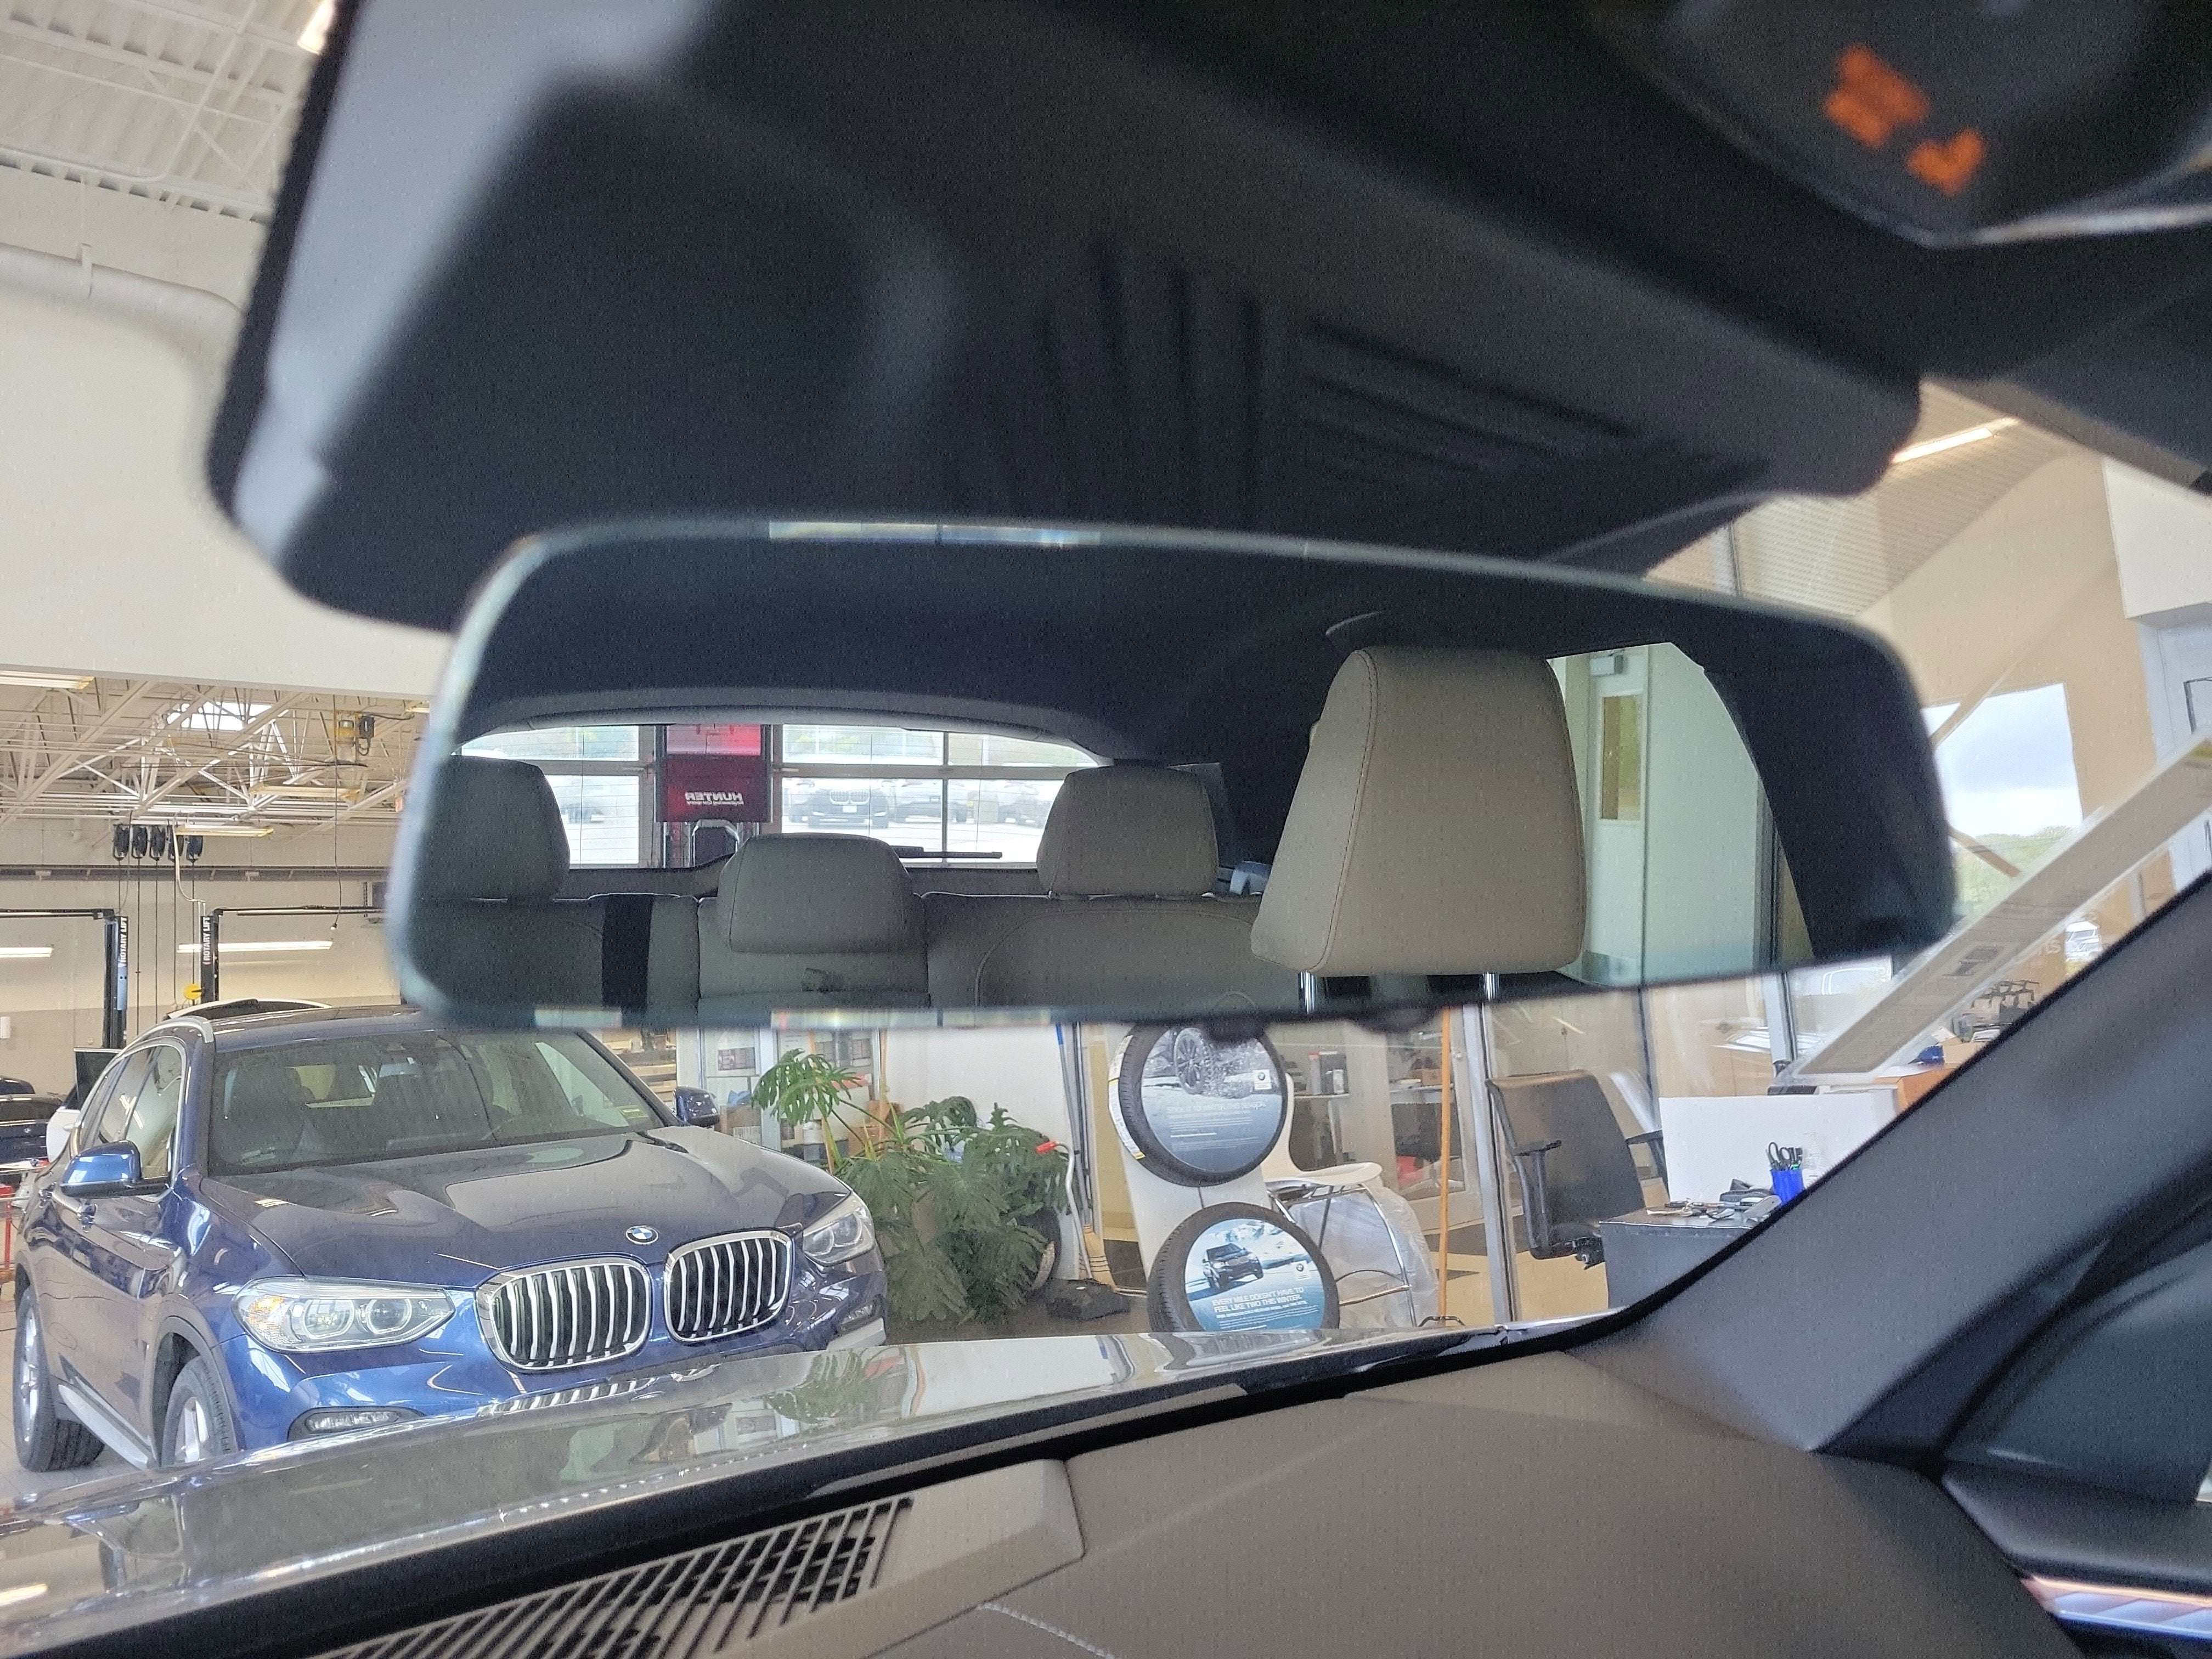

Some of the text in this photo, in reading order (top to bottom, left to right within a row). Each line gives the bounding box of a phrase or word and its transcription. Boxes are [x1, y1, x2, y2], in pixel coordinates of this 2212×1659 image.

[1212, 1297, 1233, 1306] EVERY
[1214, 1305, 1231, 1313] FEEL
[1230, 1302, 1247, 1311] LIKE
[1261, 1297, 1276, 1306] THIS
